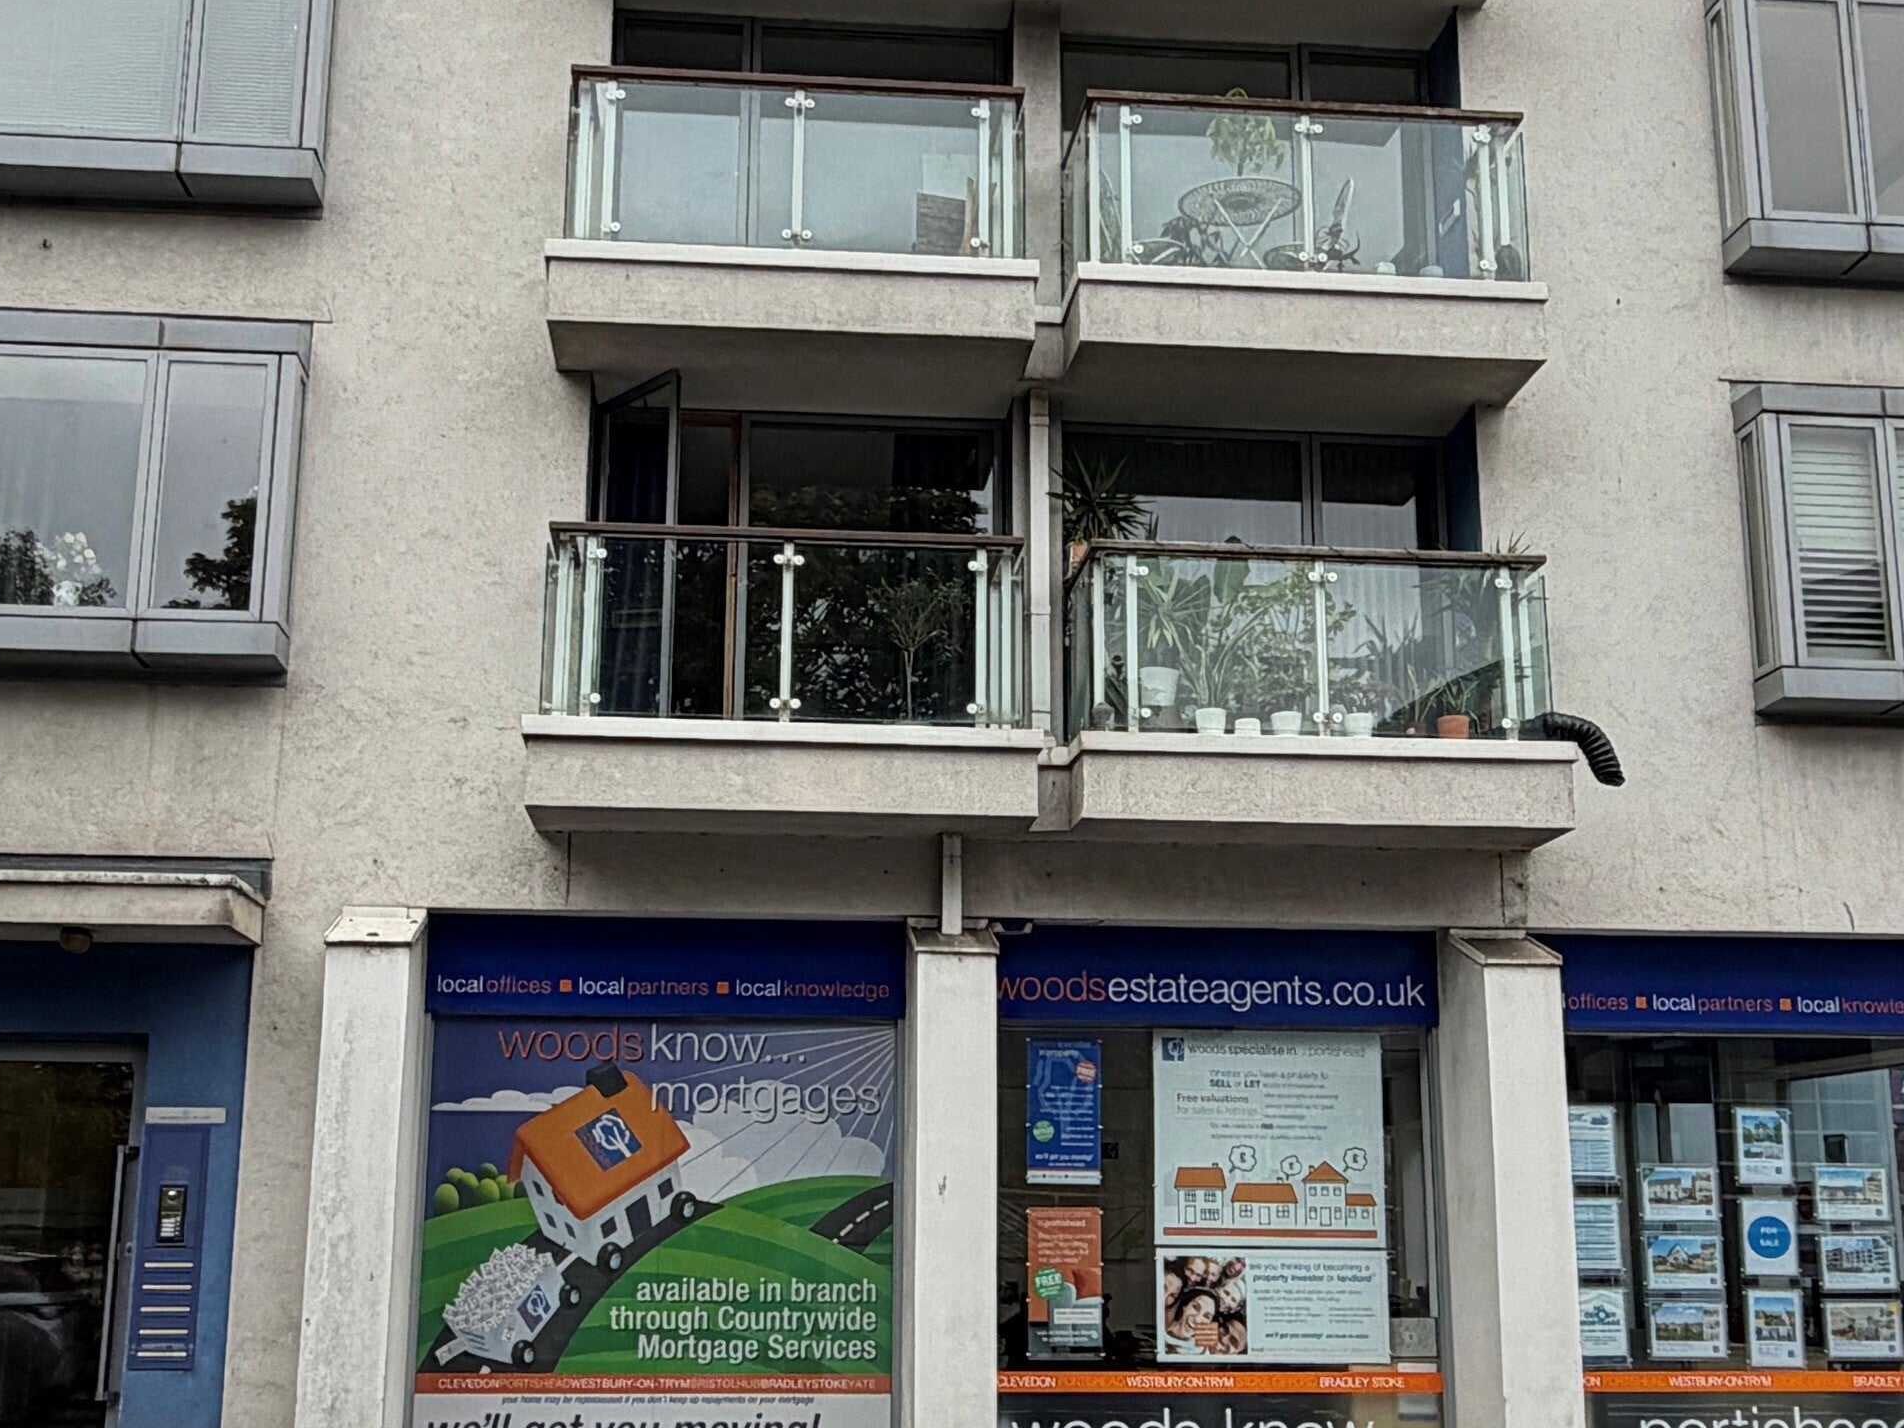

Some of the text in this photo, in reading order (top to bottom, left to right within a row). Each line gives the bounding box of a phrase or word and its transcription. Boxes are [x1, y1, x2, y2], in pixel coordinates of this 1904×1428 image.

[498, 1025, 644, 1062] woods
[652, 1076, 882, 1123] mortgages
[636, 1278, 877, 1302] available in branch
[609, 1305, 877, 1335] through Countrywide
[637, 1334, 877, 1364] Mortgage Services
